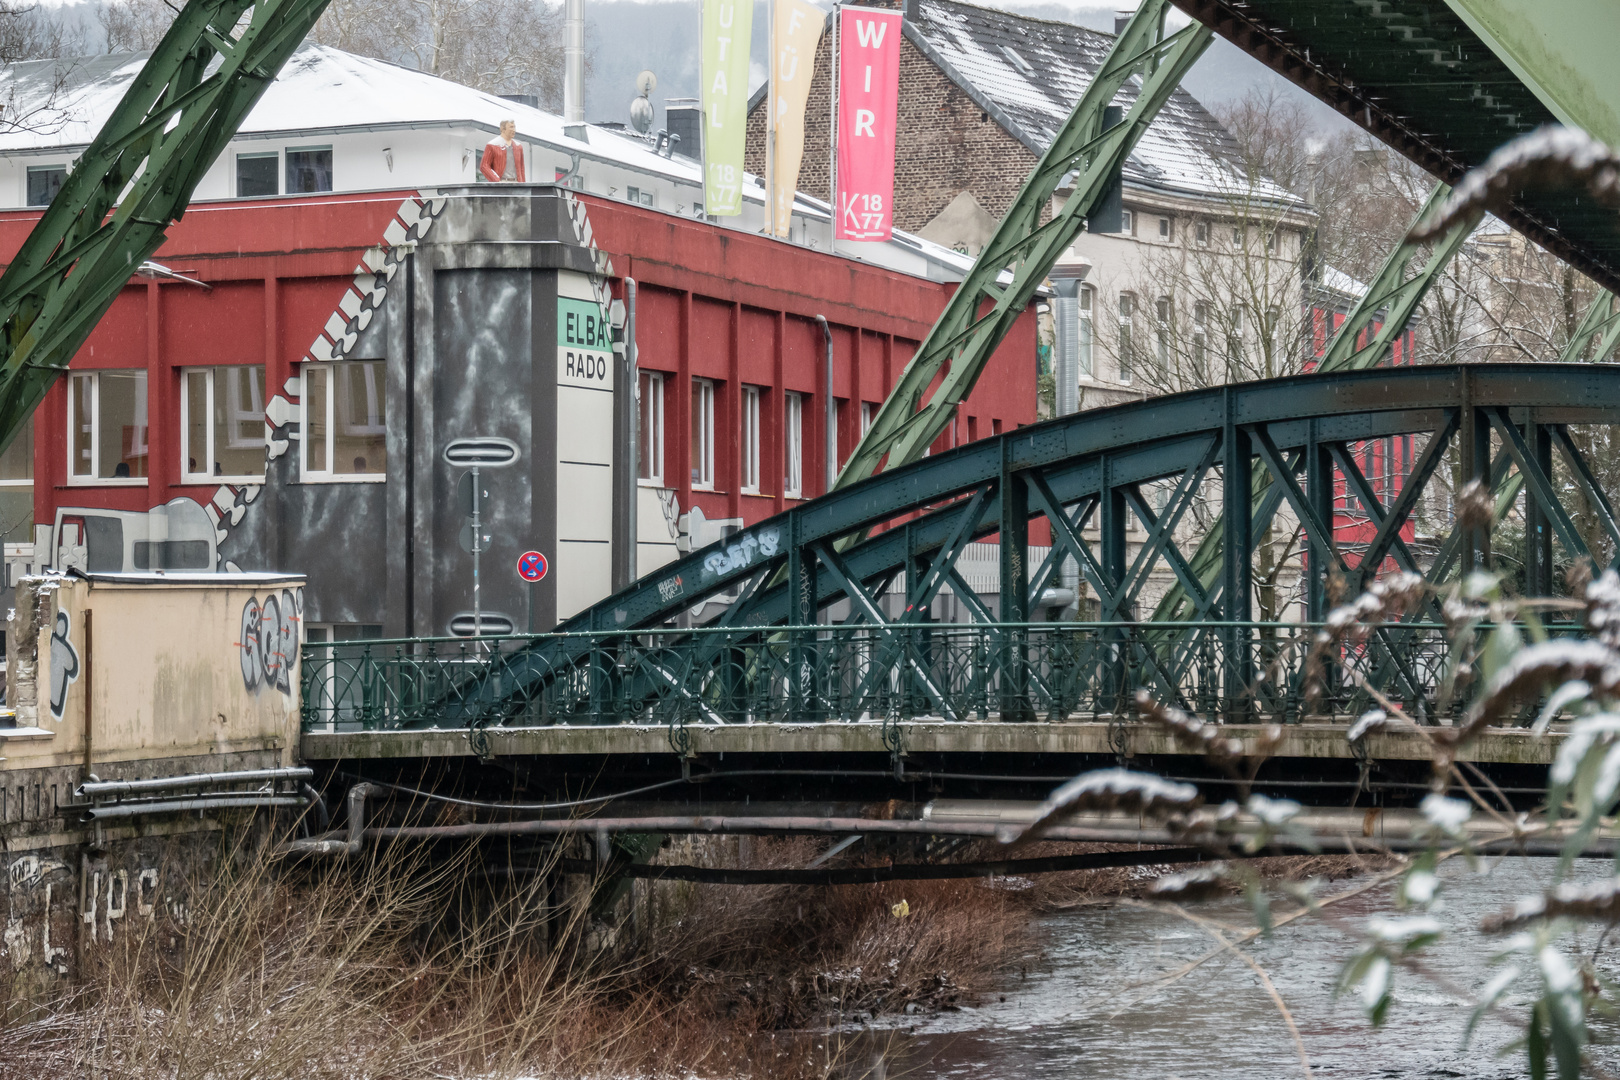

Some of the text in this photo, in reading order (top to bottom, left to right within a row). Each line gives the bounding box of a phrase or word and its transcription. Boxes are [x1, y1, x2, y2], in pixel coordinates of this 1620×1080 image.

[712, 4, 734, 128] UTAL
[855, 19, 887, 137] WIR
[861, 194, 883, 211] 18
[861, 213, 884, 230] 77
[566, 312, 606, 348] ELBA
[566, 352, 606, 381] RADO
